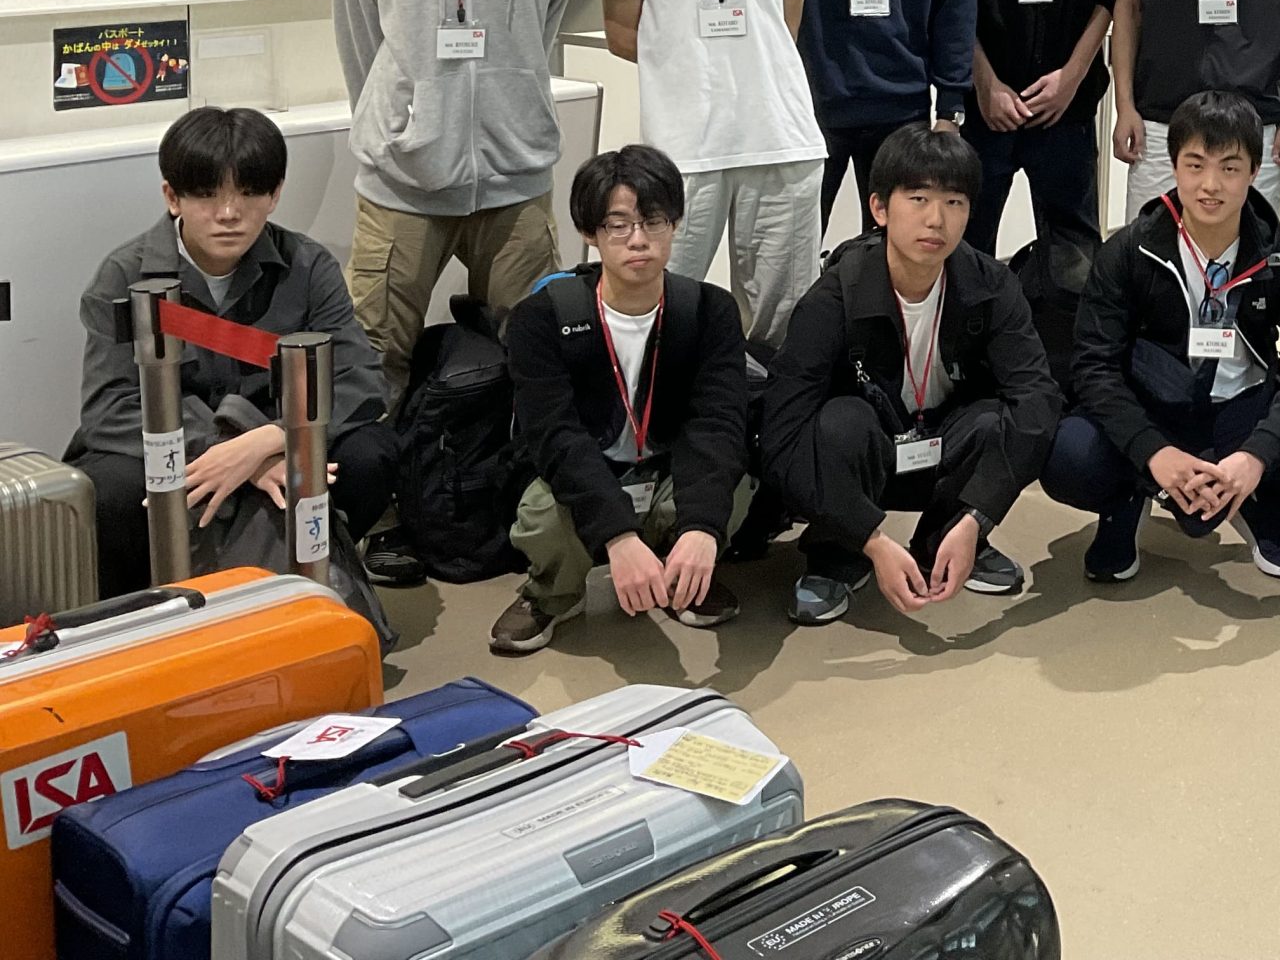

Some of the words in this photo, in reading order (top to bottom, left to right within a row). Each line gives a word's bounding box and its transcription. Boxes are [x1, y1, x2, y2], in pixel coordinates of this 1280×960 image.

[98, 27, 144, 39] パスポート
[14, 751, 117, 836] ISA
[785, 917, 814, 934] MADE
